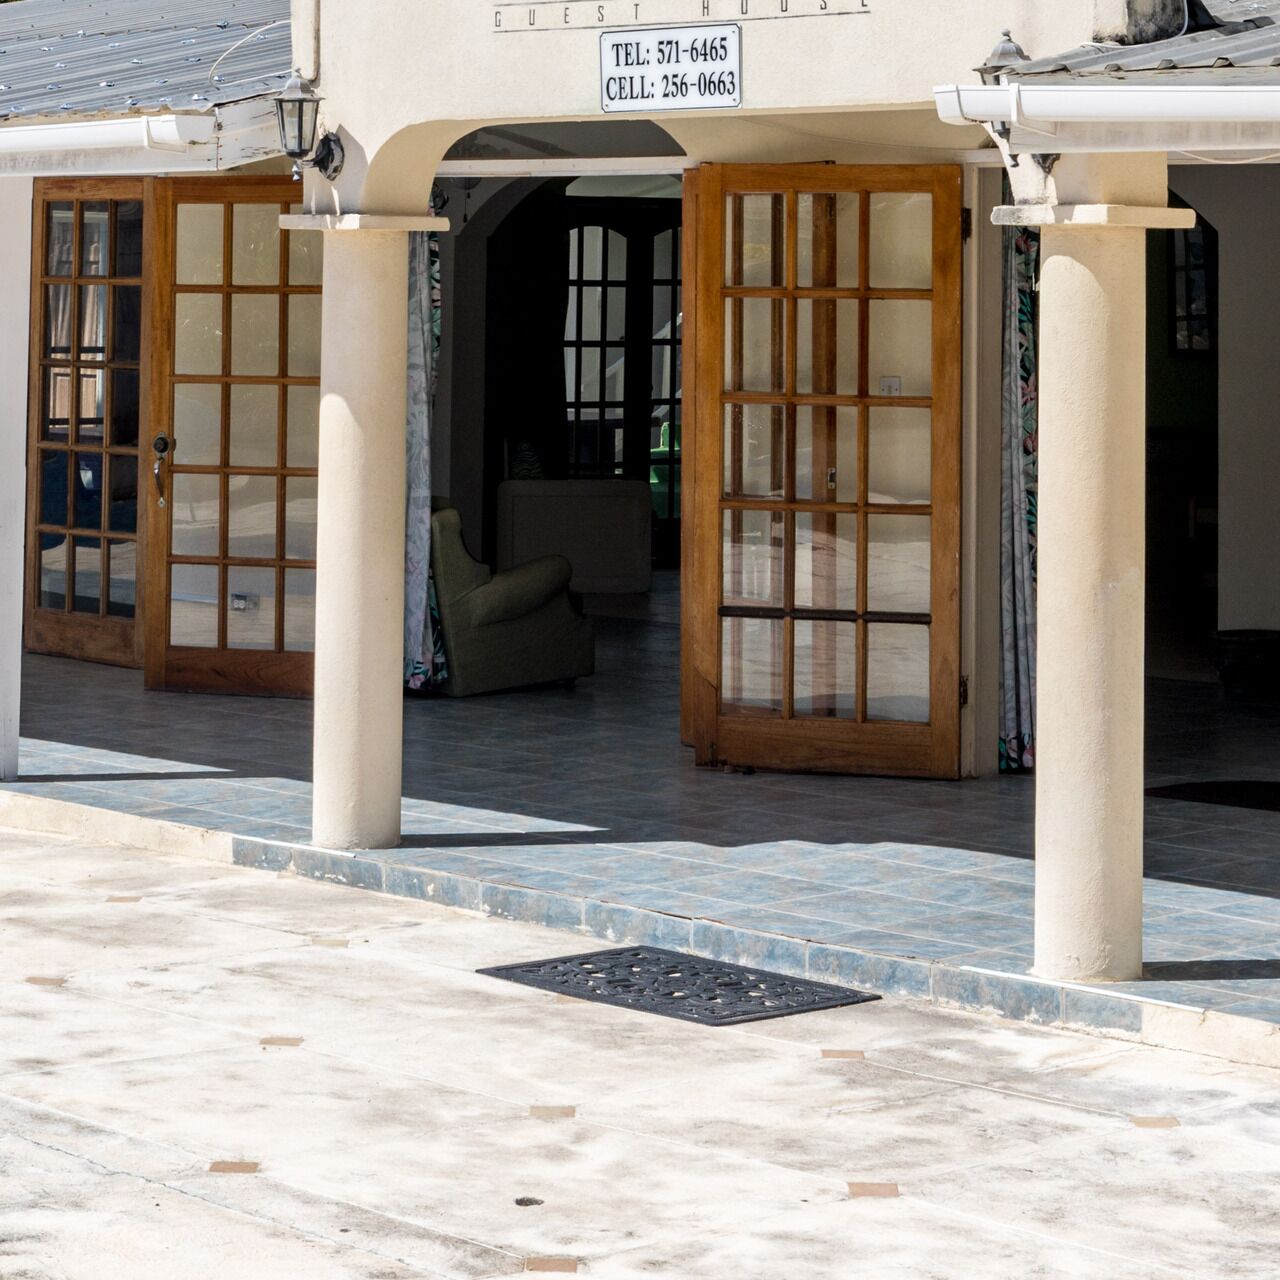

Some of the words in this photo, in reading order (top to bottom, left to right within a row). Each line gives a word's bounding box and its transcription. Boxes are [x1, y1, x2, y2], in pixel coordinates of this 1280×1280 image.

[495, 4, 640, 27] GUEST
[612, 42, 650, 67] TEL:
[657, 37, 728, 65] 571-6465
[606, 75, 655, 101] CELL:
[662, 71, 736, 98] 256-0663
